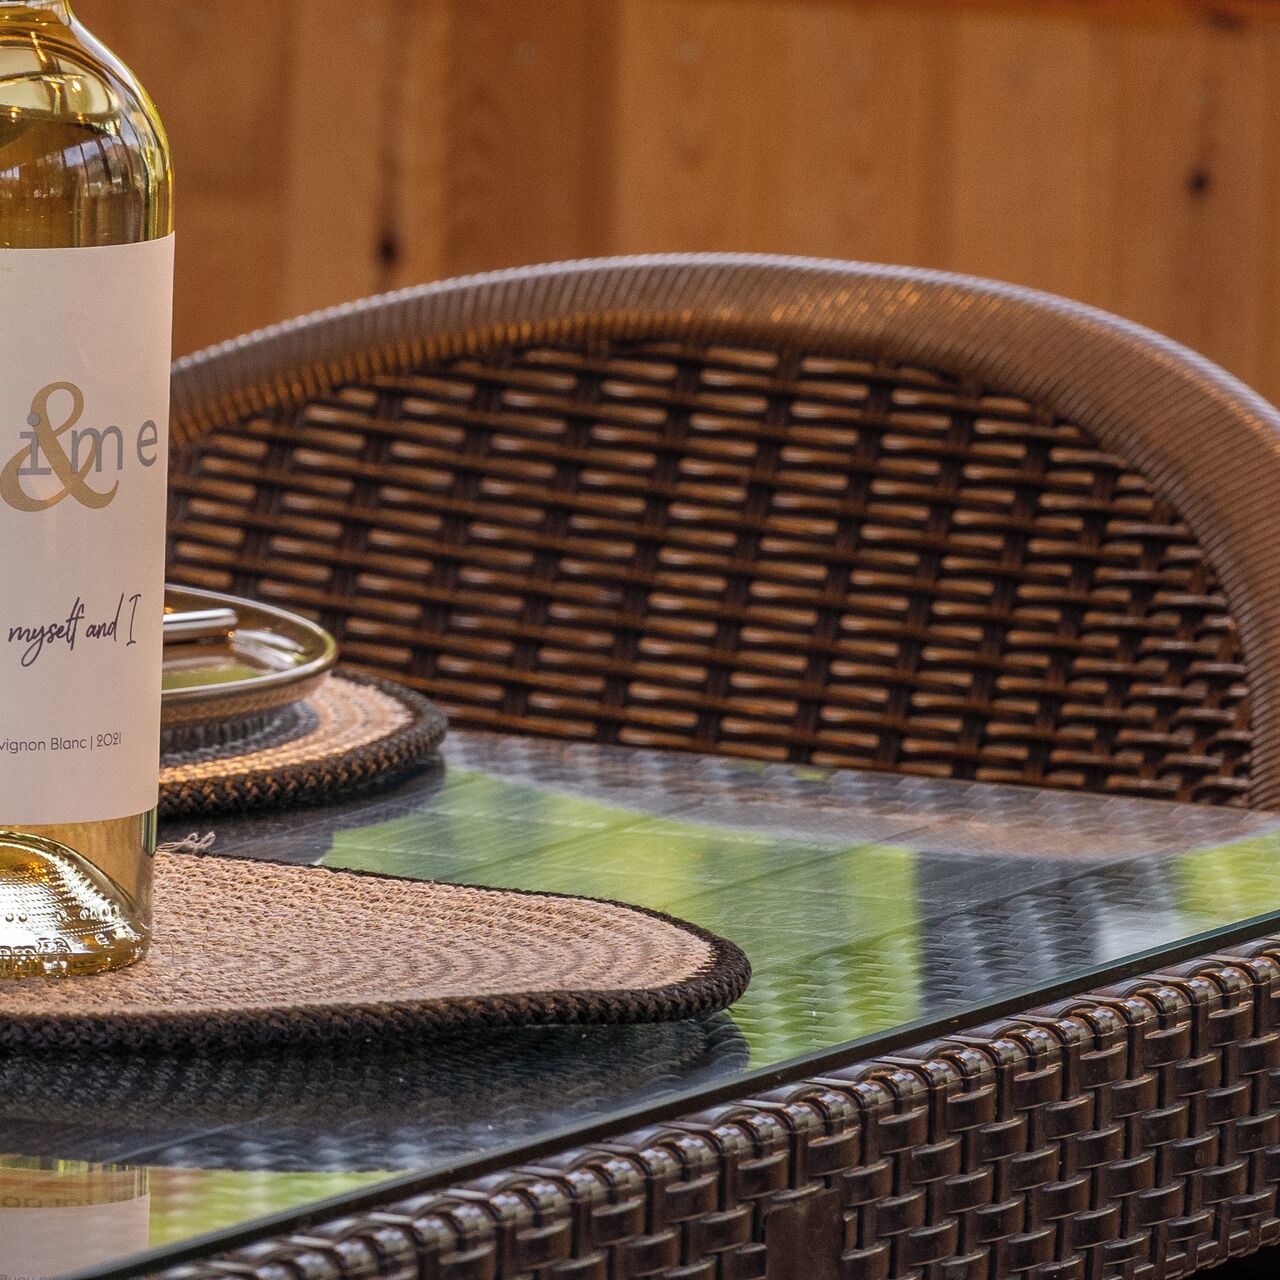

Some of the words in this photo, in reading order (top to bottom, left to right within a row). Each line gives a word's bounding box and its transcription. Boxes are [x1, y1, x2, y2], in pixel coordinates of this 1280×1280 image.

[8, 596, 85, 668] myself
[86, 592, 125, 642] and
[126, 593, 142, 647] I
[50, 736, 88, 751] Blanc
[96, 731, 122, 748] 2021
